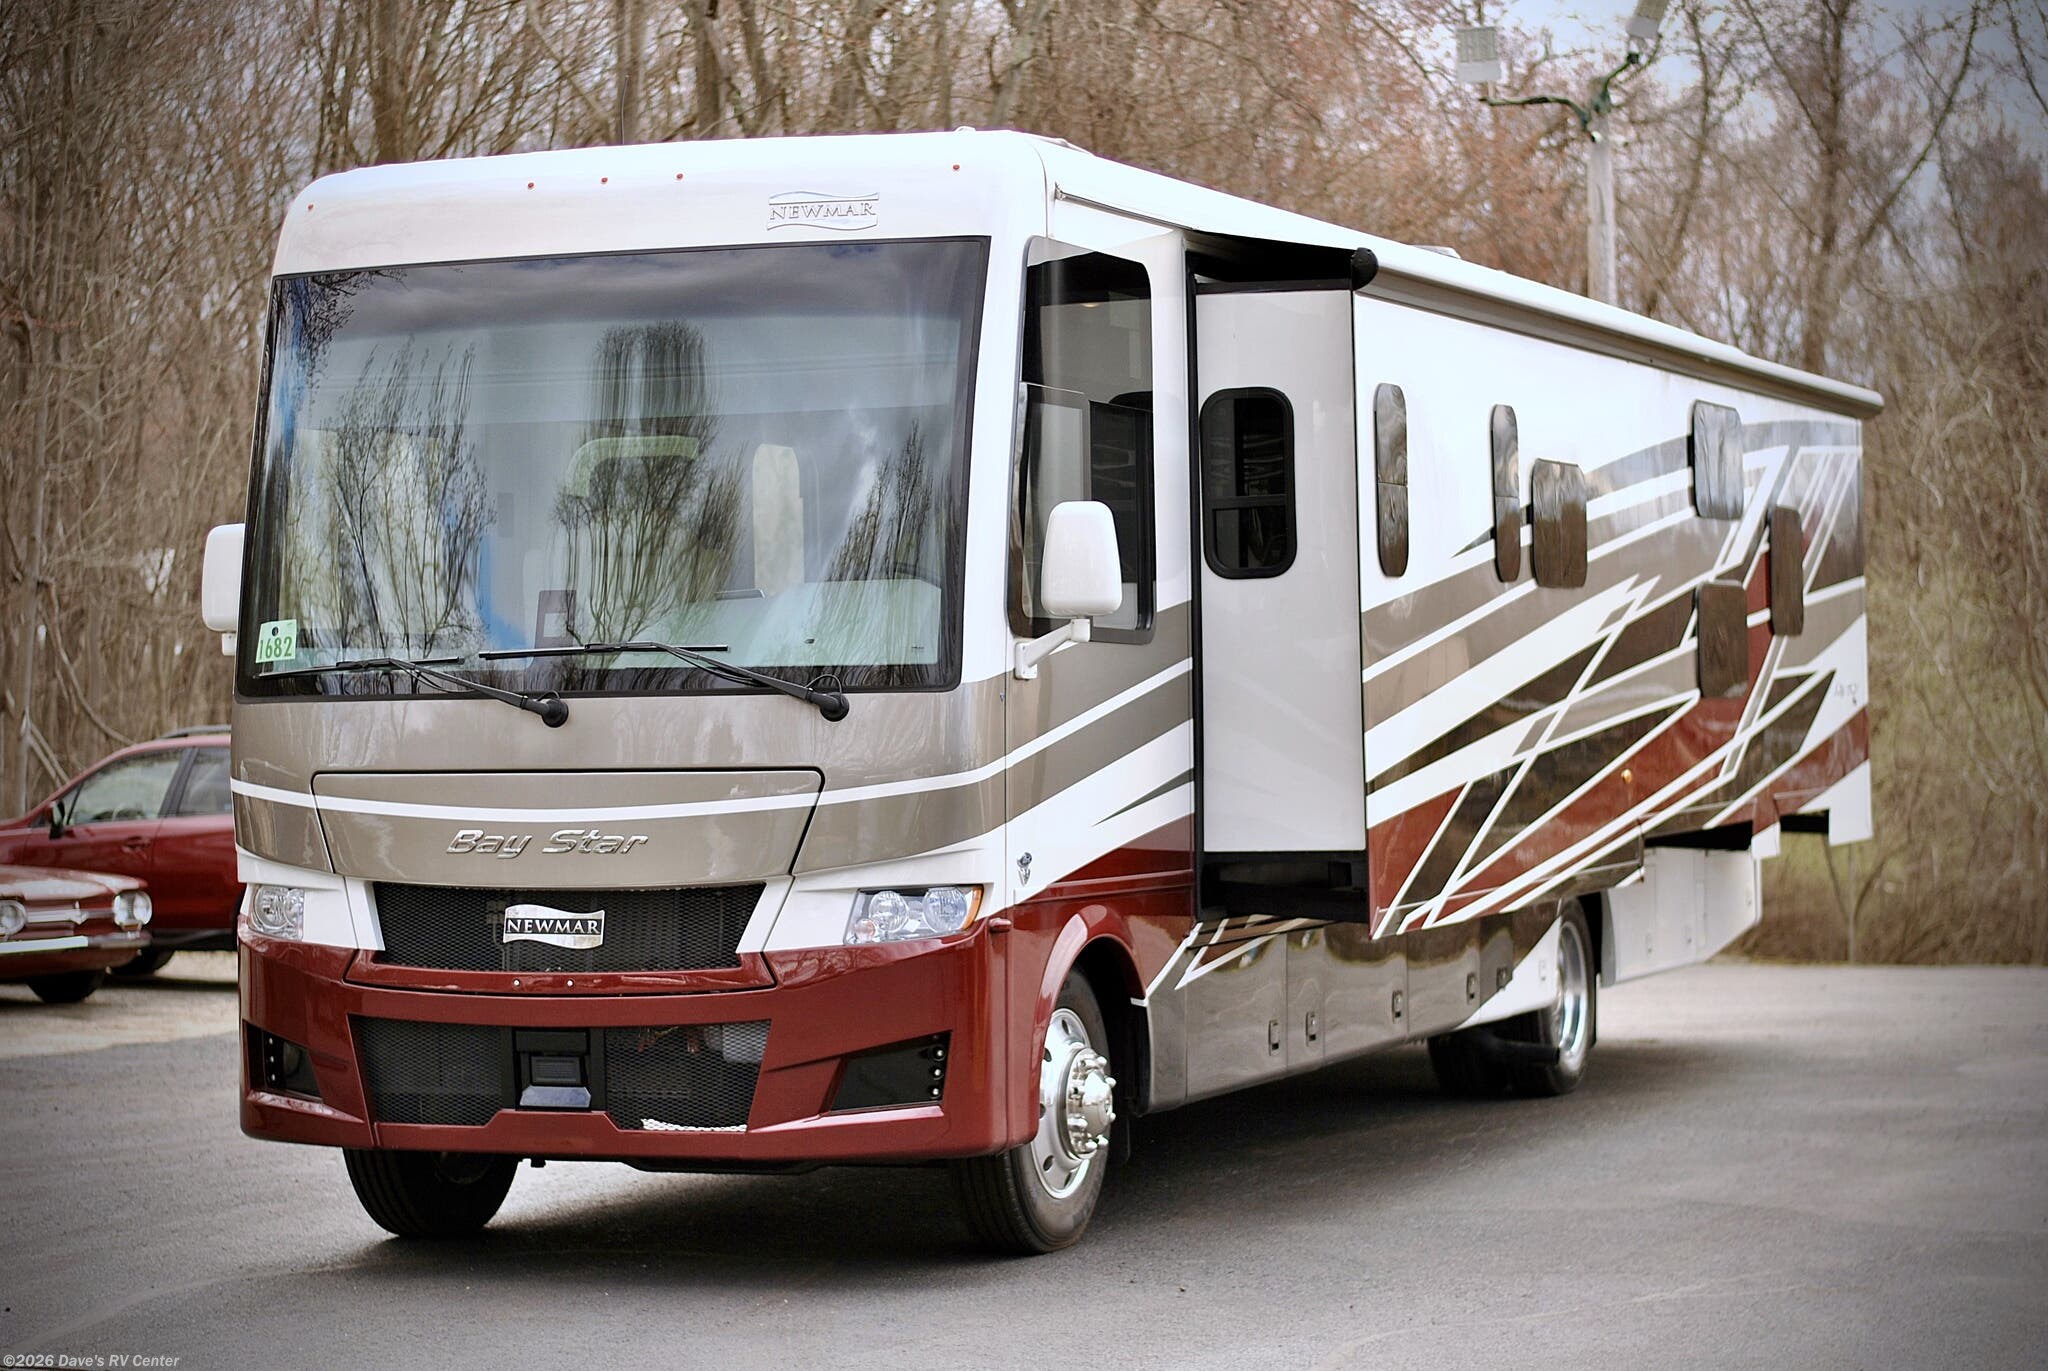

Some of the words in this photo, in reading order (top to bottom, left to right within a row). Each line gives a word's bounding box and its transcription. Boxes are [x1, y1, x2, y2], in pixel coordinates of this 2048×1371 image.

[770, 203, 876, 220] NEWMAR
[260, 636, 293, 660] 1682
[447, 829, 533, 859] Bay
[542, 829, 649, 854] Star
[505, 919, 600, 934] NEWMAR
